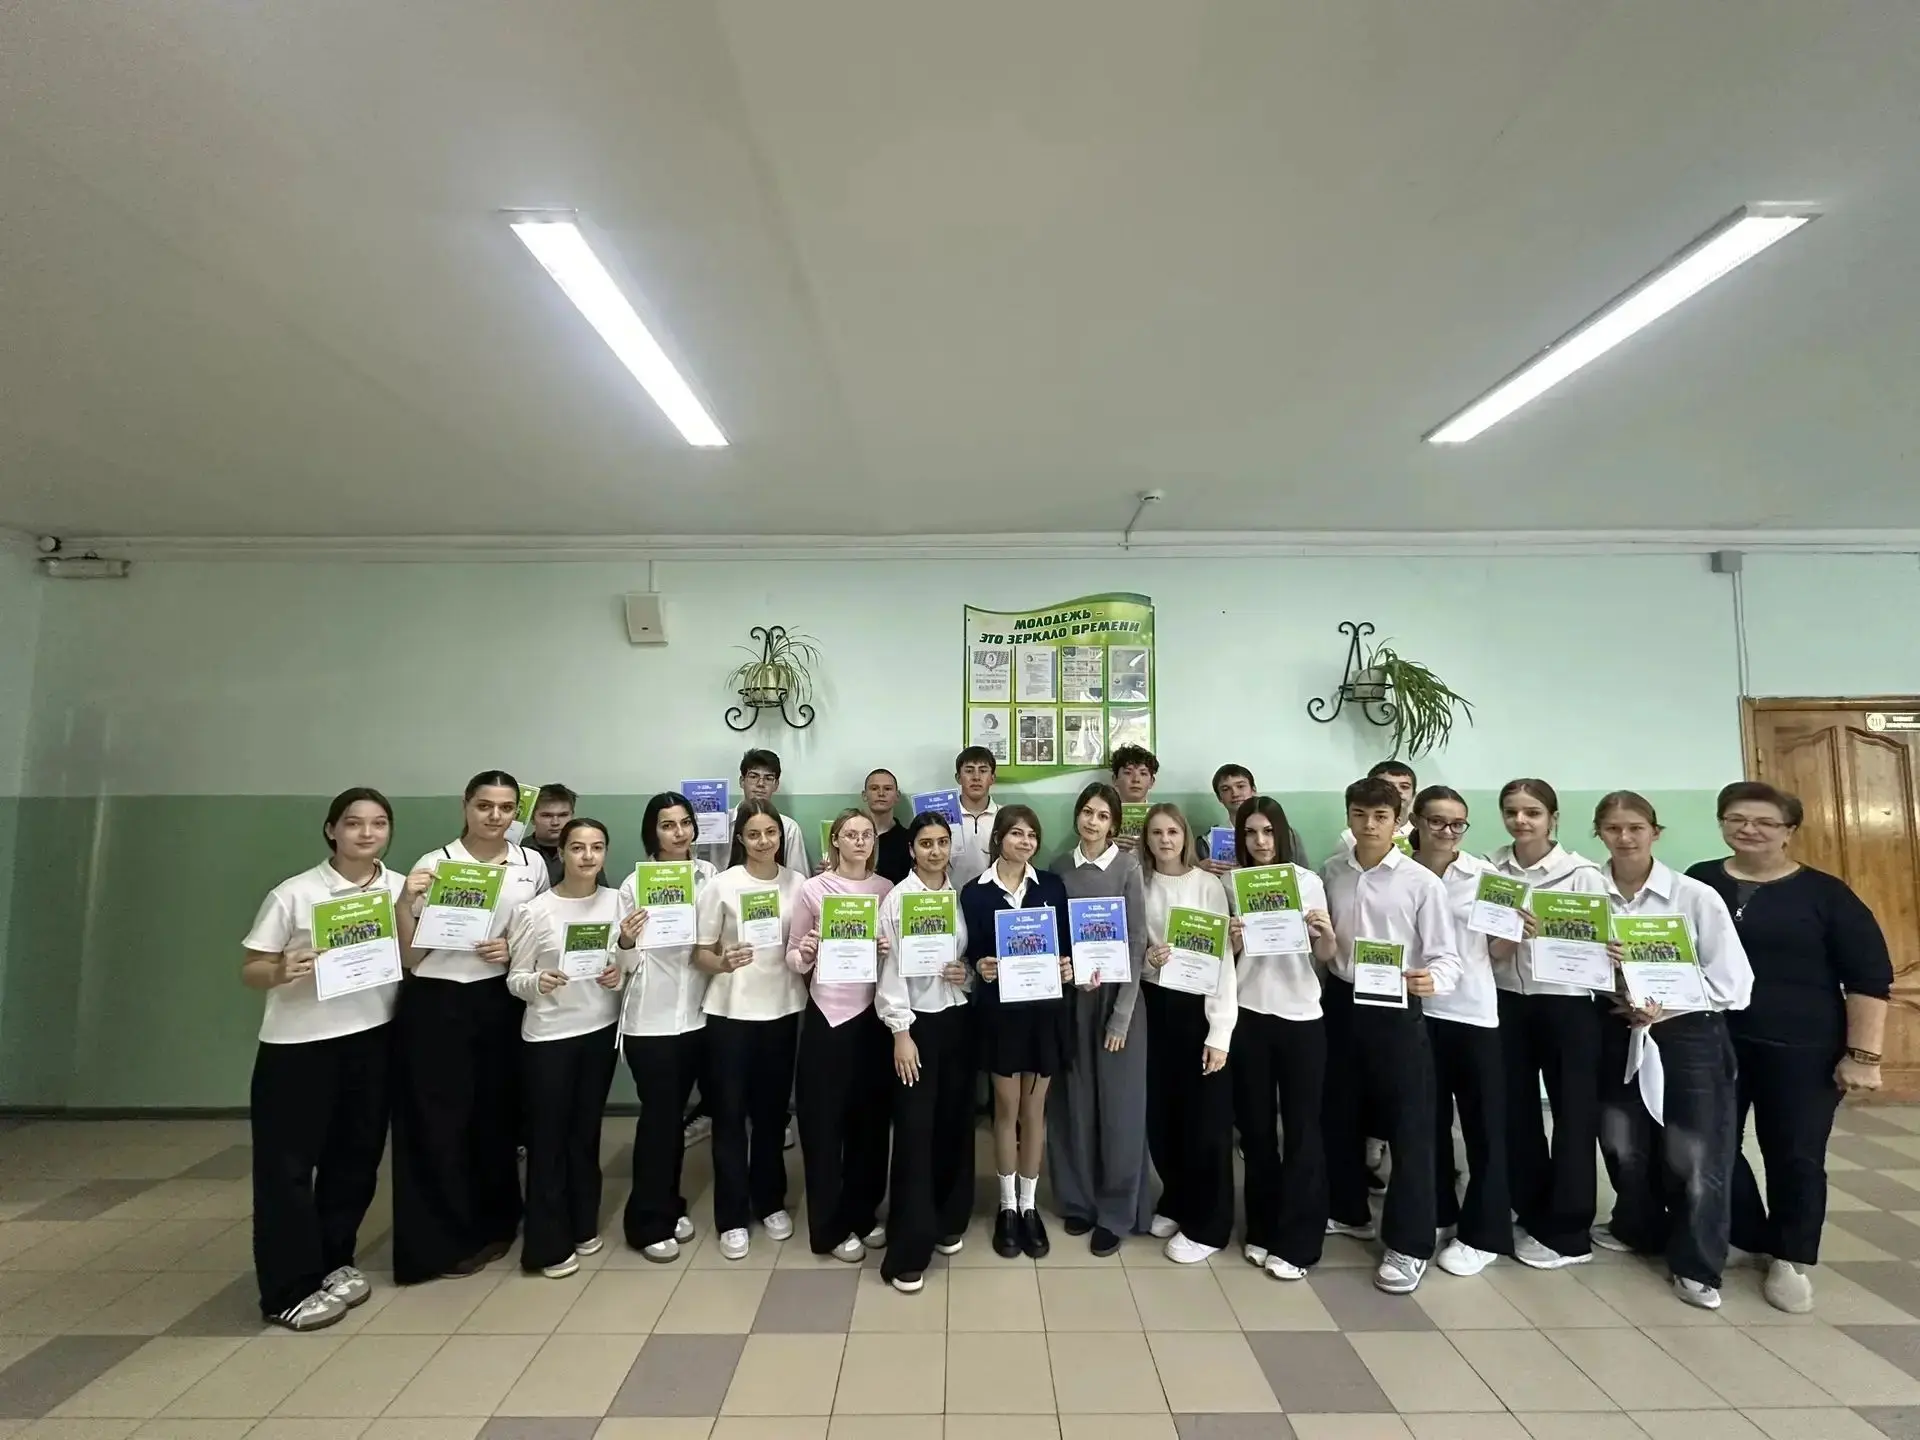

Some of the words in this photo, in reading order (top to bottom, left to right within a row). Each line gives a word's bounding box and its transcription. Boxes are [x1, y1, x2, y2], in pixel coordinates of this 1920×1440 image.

[1014, 609, 1091, 630] МОЛОДЕЖЬ
[979, 633, 1003, 645] ЭТО
[1006, 628, 1067, 645] ЗЕРКАЛО
[1071, 621, 1140, 635] ВРЕМЕНИ
